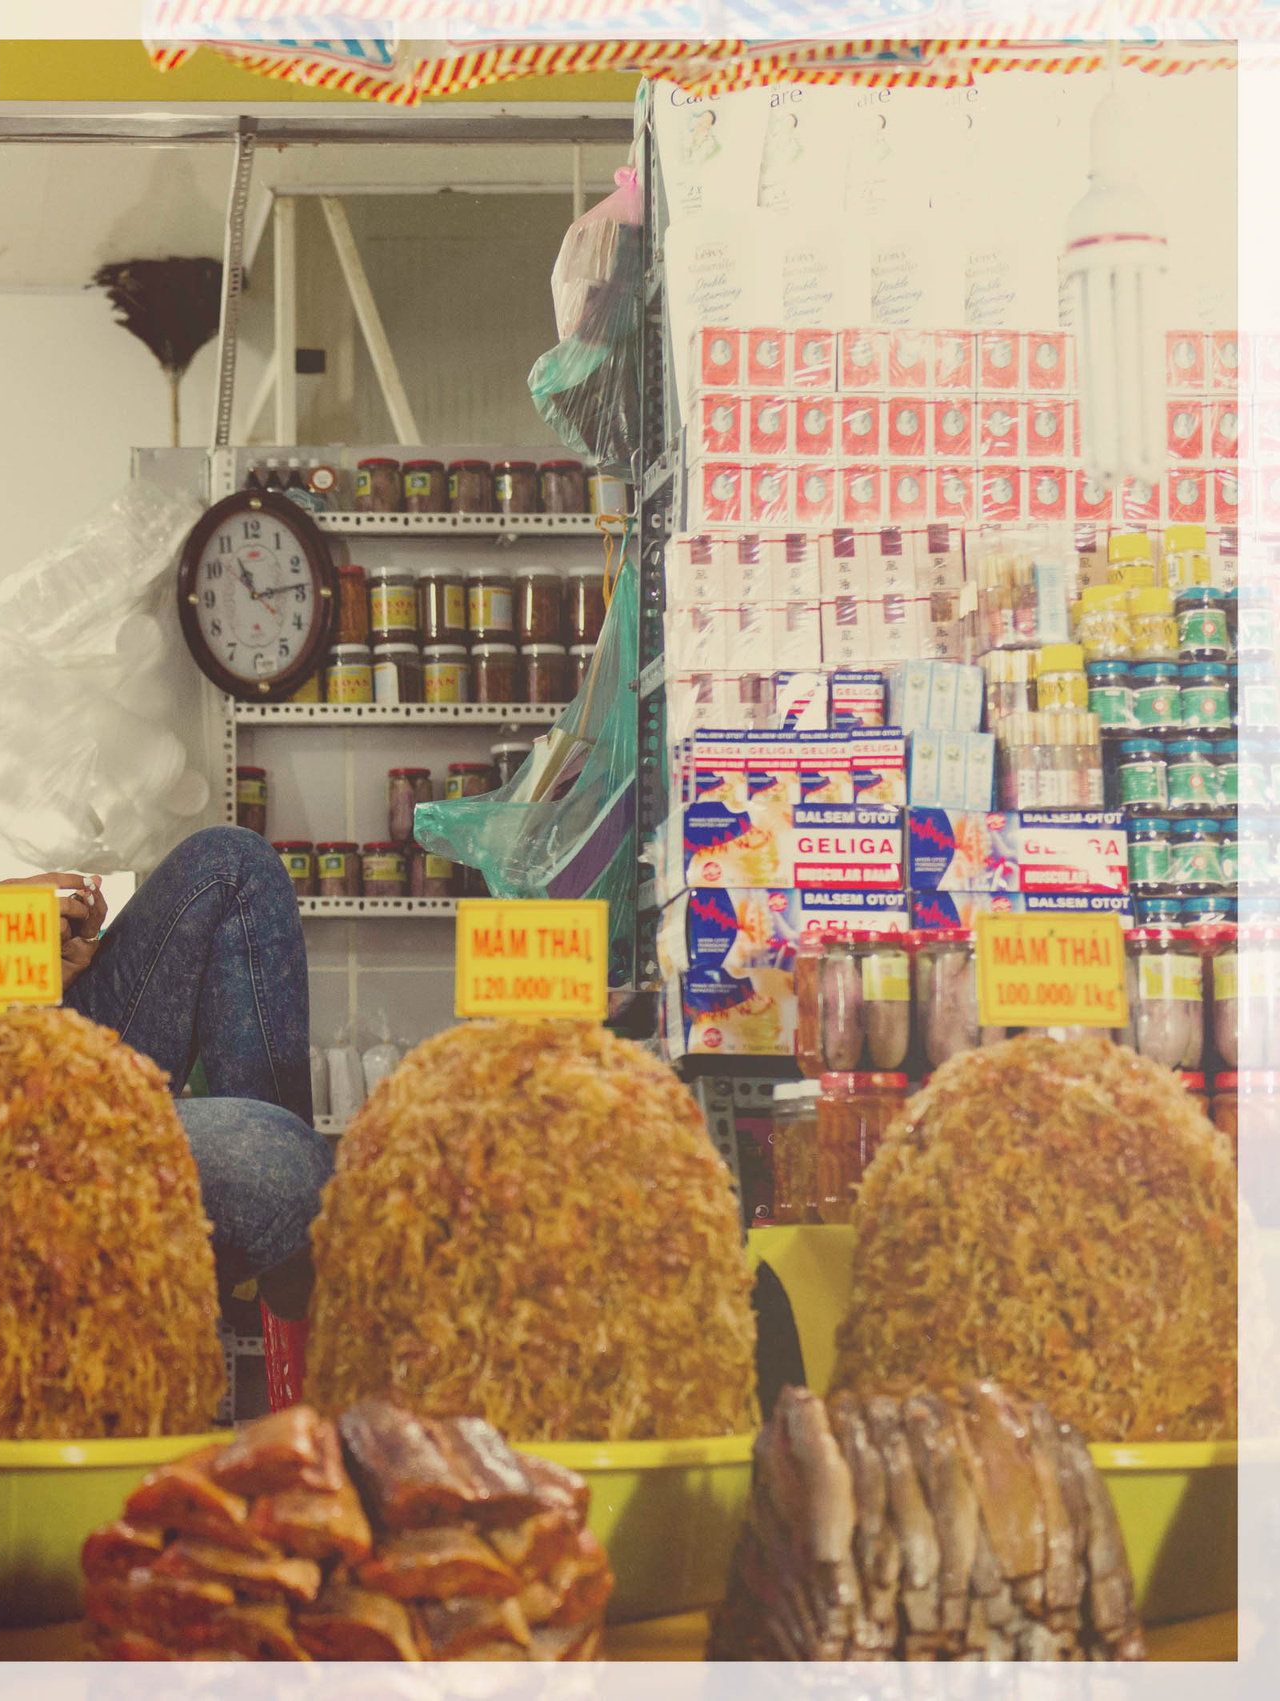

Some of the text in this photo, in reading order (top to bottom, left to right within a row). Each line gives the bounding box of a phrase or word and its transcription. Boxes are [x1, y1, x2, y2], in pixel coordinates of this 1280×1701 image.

[244, 520, 260, 539] 12
[219, 536, 232, 554] 11
[274, 533, 282, 550] 1
[207, 562, 222, 580] 10
[290, 556, 300, 574] 2
[205, 590, 216, 609] 9
[211, 619, 222, 636] 8
[292, 613, 303, 631] 4
[227, 642, 237, 661] 7
[278, 638, 289, 657] 5
[696, 747, 742, 755] GELIGA
[748, 747, 794, 755] GELIGA
[801, 747, 846, 755] GELIGA
[854, 744, 898, 753] GELIGA
[796, 810, 898, 825] BALSEM OTOT
[1022, 811, 1124, 825] BALSEM OTOT
[797, 837, 895, 854] GELIGA
[804, 893, 906, 906] BALSEM OTOT
[1028, 896, 1131, 909] BALSEM OTOT
[536, 918, 592, 958] THÁI
[1057, 928, 1112, 967] THÁI
